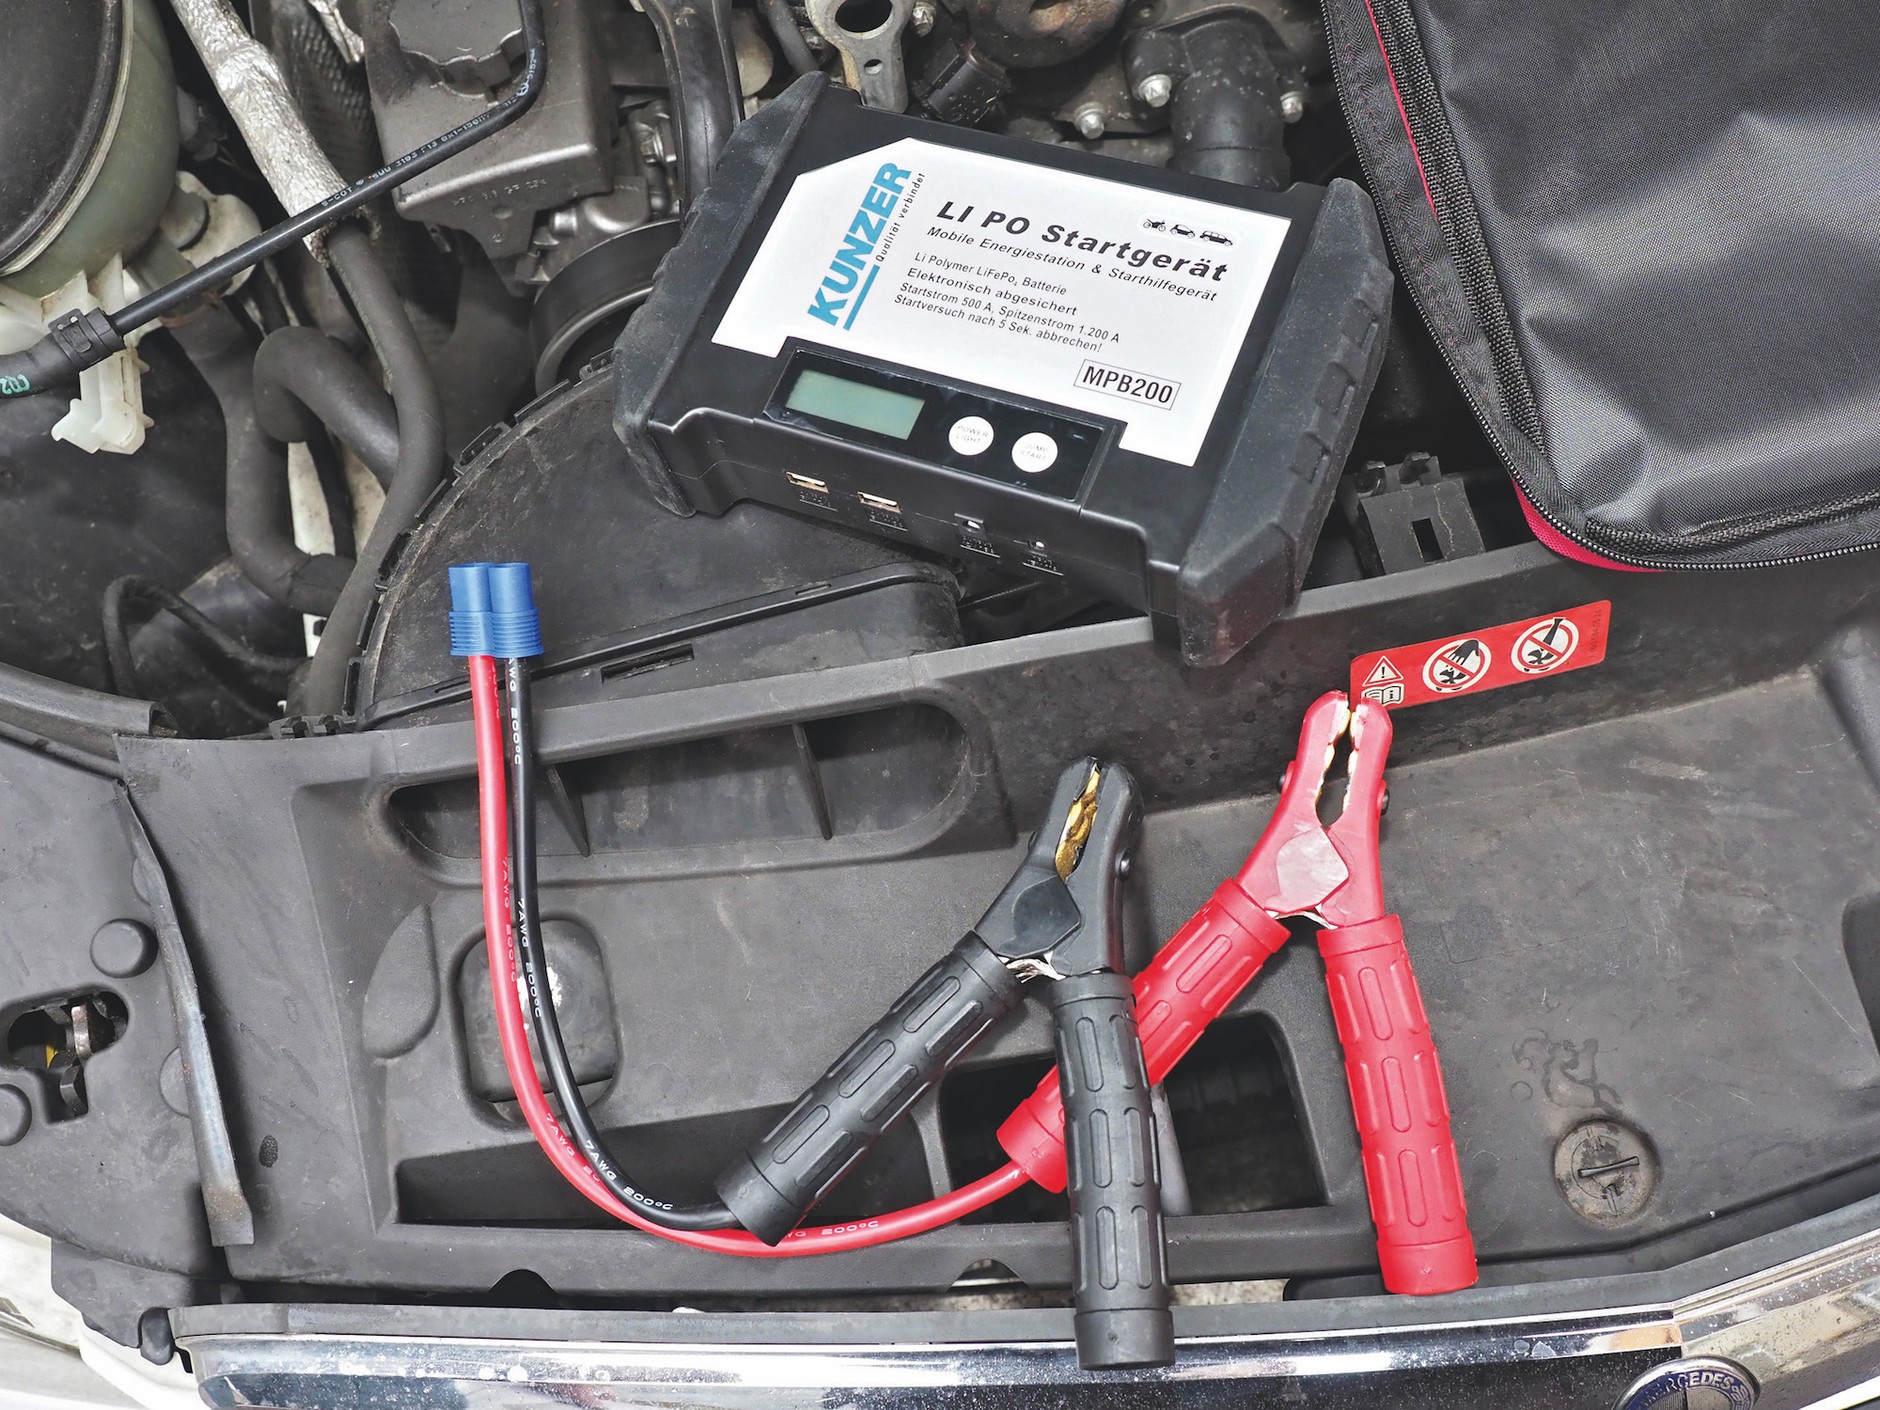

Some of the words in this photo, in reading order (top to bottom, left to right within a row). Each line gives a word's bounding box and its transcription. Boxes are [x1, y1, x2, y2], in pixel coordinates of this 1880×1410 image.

[875, 222, 901, 262] Qualität
[898, 173, 925, 219] verbindet
[936, 201, 974, 223] LI
[980, 210, 1030, 235] PO
[1041, 224, 1228, 282] Startgerät
[807, 162, 912, 326] KUNZER
[926, 226, 975, 245] Mobile
[979, 238, 1086, 270] Energiestation
[1091, 263, 1102, 274] &
[1108, 267, 1217, 302] Starthilfegerät
[907, 267, 992, 296] Elektronisch
[995, 287, 1077, 317] abgesichert
[914, 252, 927, 262] Li
[928, 254, 975, 274] Polymer
[1022, 276, 1067, 296] Batterie
[894, 293, 965, 320] Startversuch
[967, 312, 996, 327] nach
[998, 319, 1006, 329] 5
[1008, 321, 1032, 336] Sek.
[1036, 328, 1103, 353] abbrechen!
[900, 282, 959, 305] Startstrom
[961, 297, 982, 310] 500
[983, 302, 994, 315] A,
[998, 305, 1075, 332] Spitzenstrom
[1078, 325, 1109, 341] 1.200
[1111, 333, 1120, 343] A
[1082, 365, 1173, 404] MPB200
[508, 657, 517, 692] AWG
[518, 898, 529, 948] 7AWG
[546, 1112, 576, 1157] 7AWG
[584, 1139, 617, 1182] 7AWG
